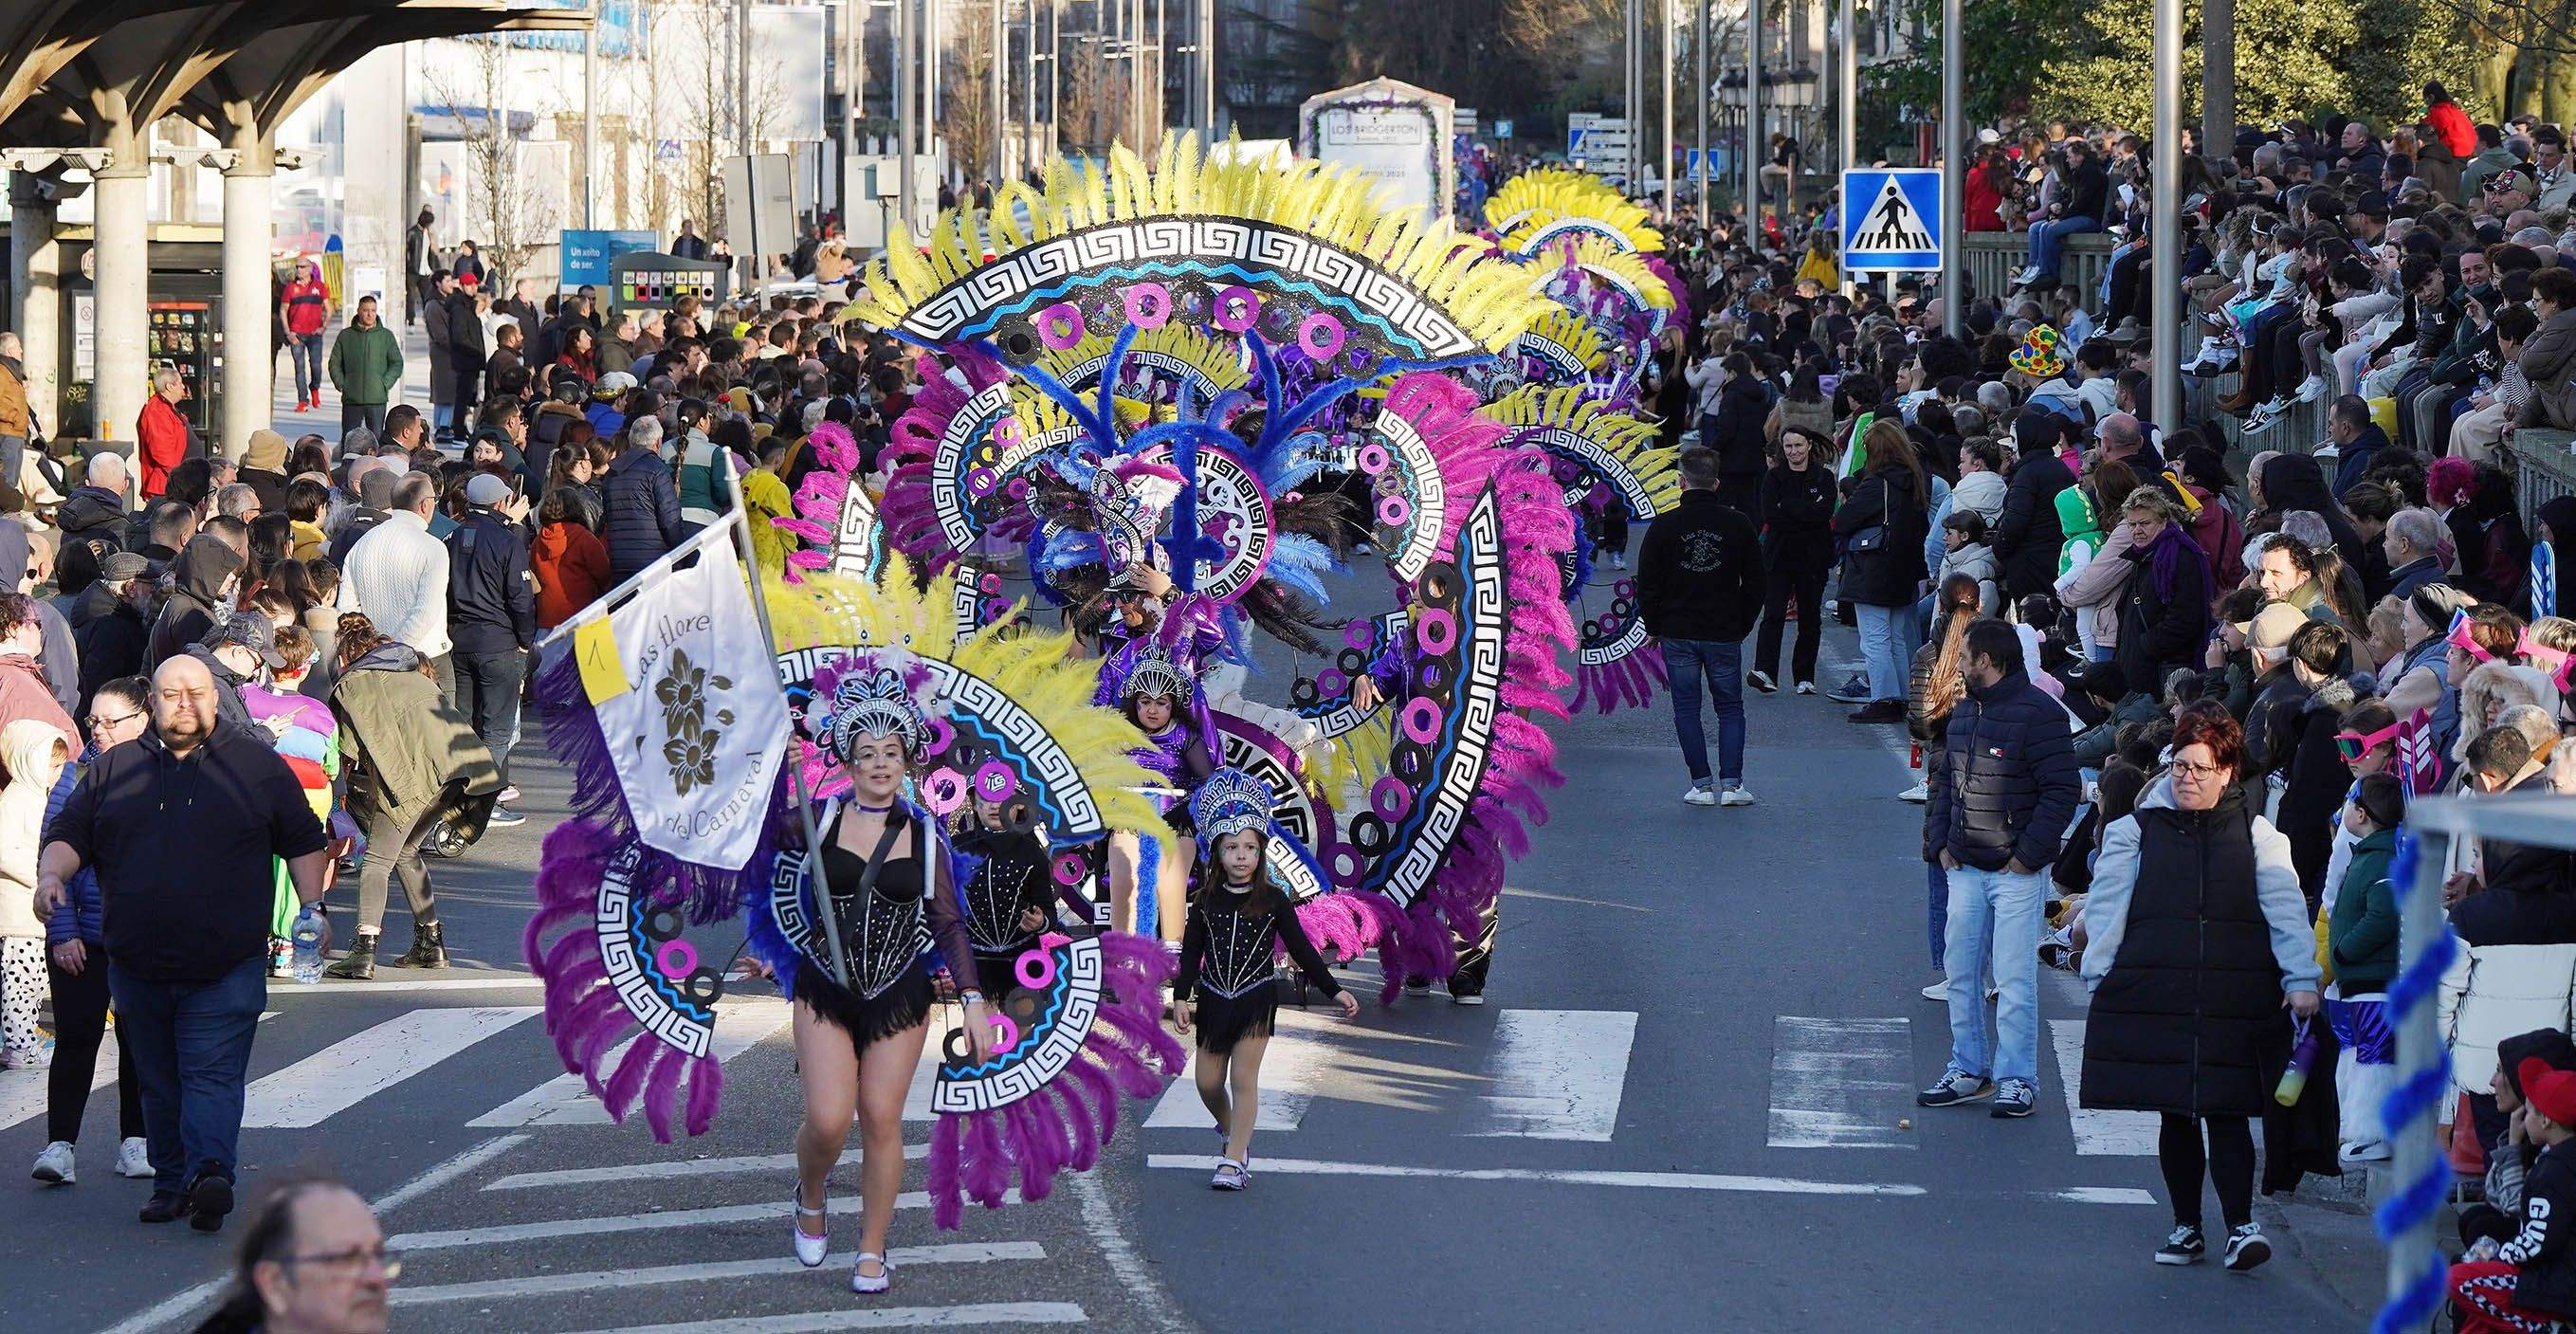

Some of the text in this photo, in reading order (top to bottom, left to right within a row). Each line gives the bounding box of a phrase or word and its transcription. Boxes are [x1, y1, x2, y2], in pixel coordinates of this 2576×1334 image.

[1331, 124, 1417, 135] LOS BRIDGERTON
[571, 247, 581, 256] Un
[570, 260, 580, 269] de
[588, 638, 606, 671] 1
[630, 613, 712, 696] Las flore
[667, 751, 764, 841] del Carnaval
